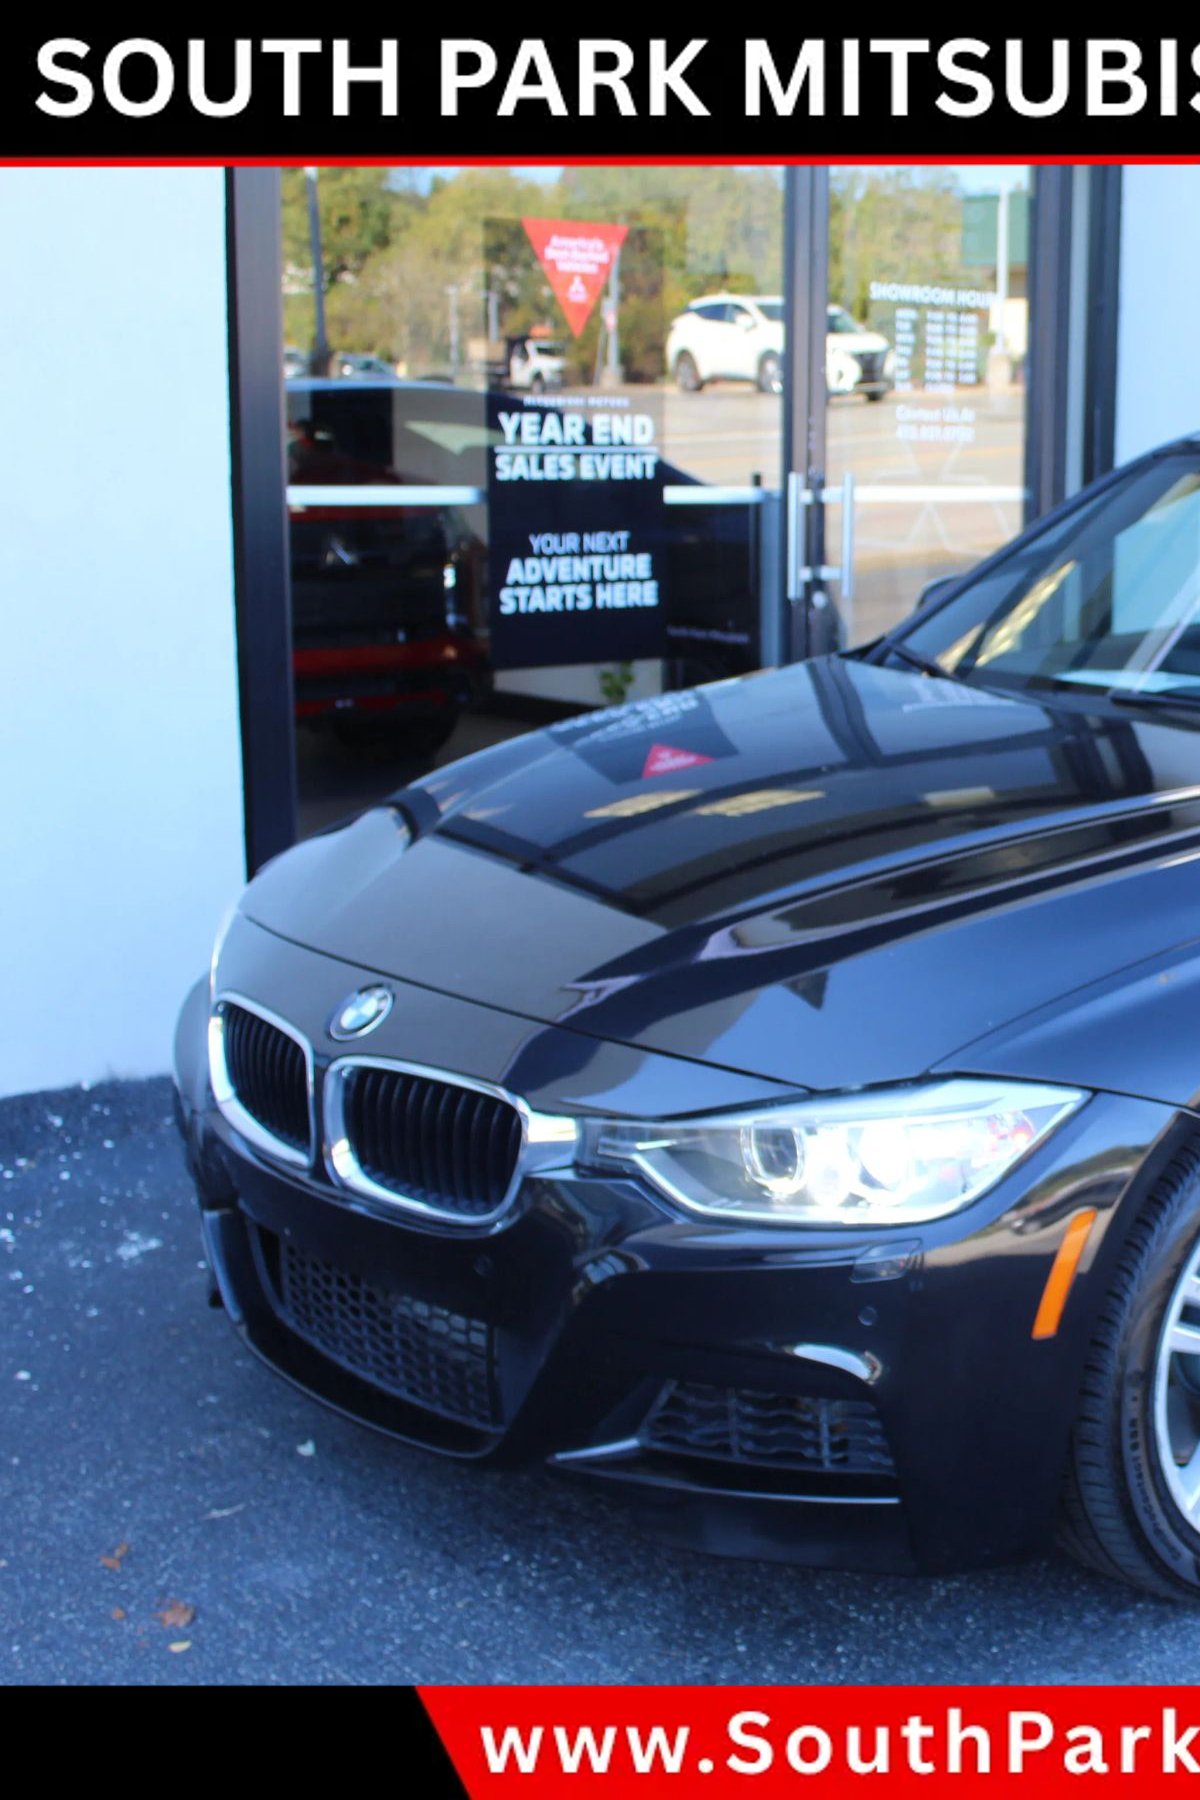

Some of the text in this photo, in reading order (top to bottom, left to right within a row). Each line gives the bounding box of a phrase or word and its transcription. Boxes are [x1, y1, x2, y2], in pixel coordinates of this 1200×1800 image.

[870, 281, 956, 306] SHOWROOM
[498, 412, 655, 445] YEAR END
[495, 454, 658, 481] SALES EVENT
[529, 530, 630, 555] YOUR NEXT
[506, 553, 652, 585] ADVENTURE
[499, 580, 659, 615] STARTS HERE
